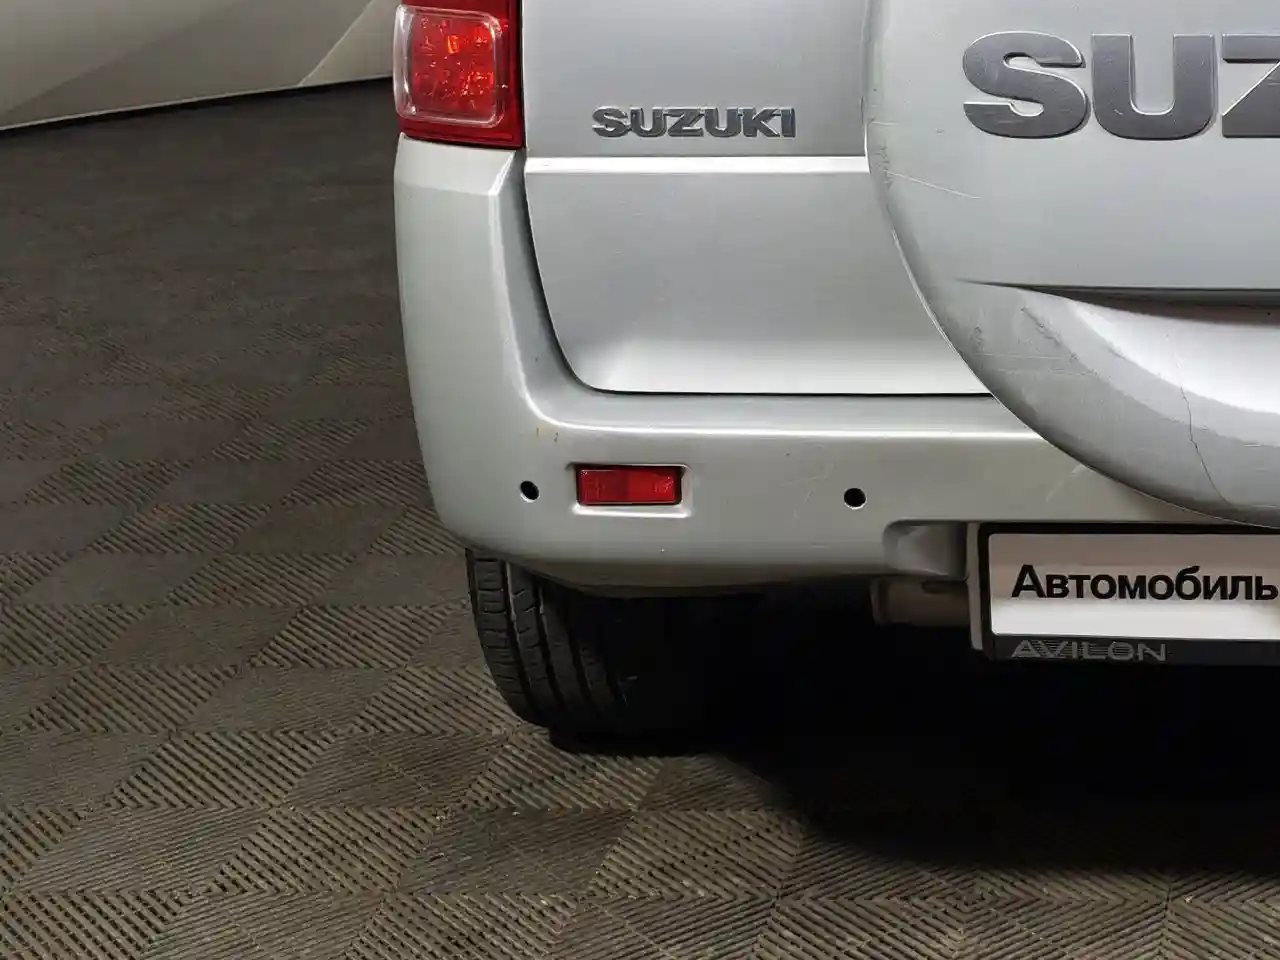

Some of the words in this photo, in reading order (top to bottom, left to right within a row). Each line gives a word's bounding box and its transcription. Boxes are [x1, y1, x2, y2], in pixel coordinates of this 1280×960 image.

[592, 105, 796, 138] SUZUKI
[1011, 564, 1279, 601] Автомобиль
[1011, 639, 1167, 662] AVILON
